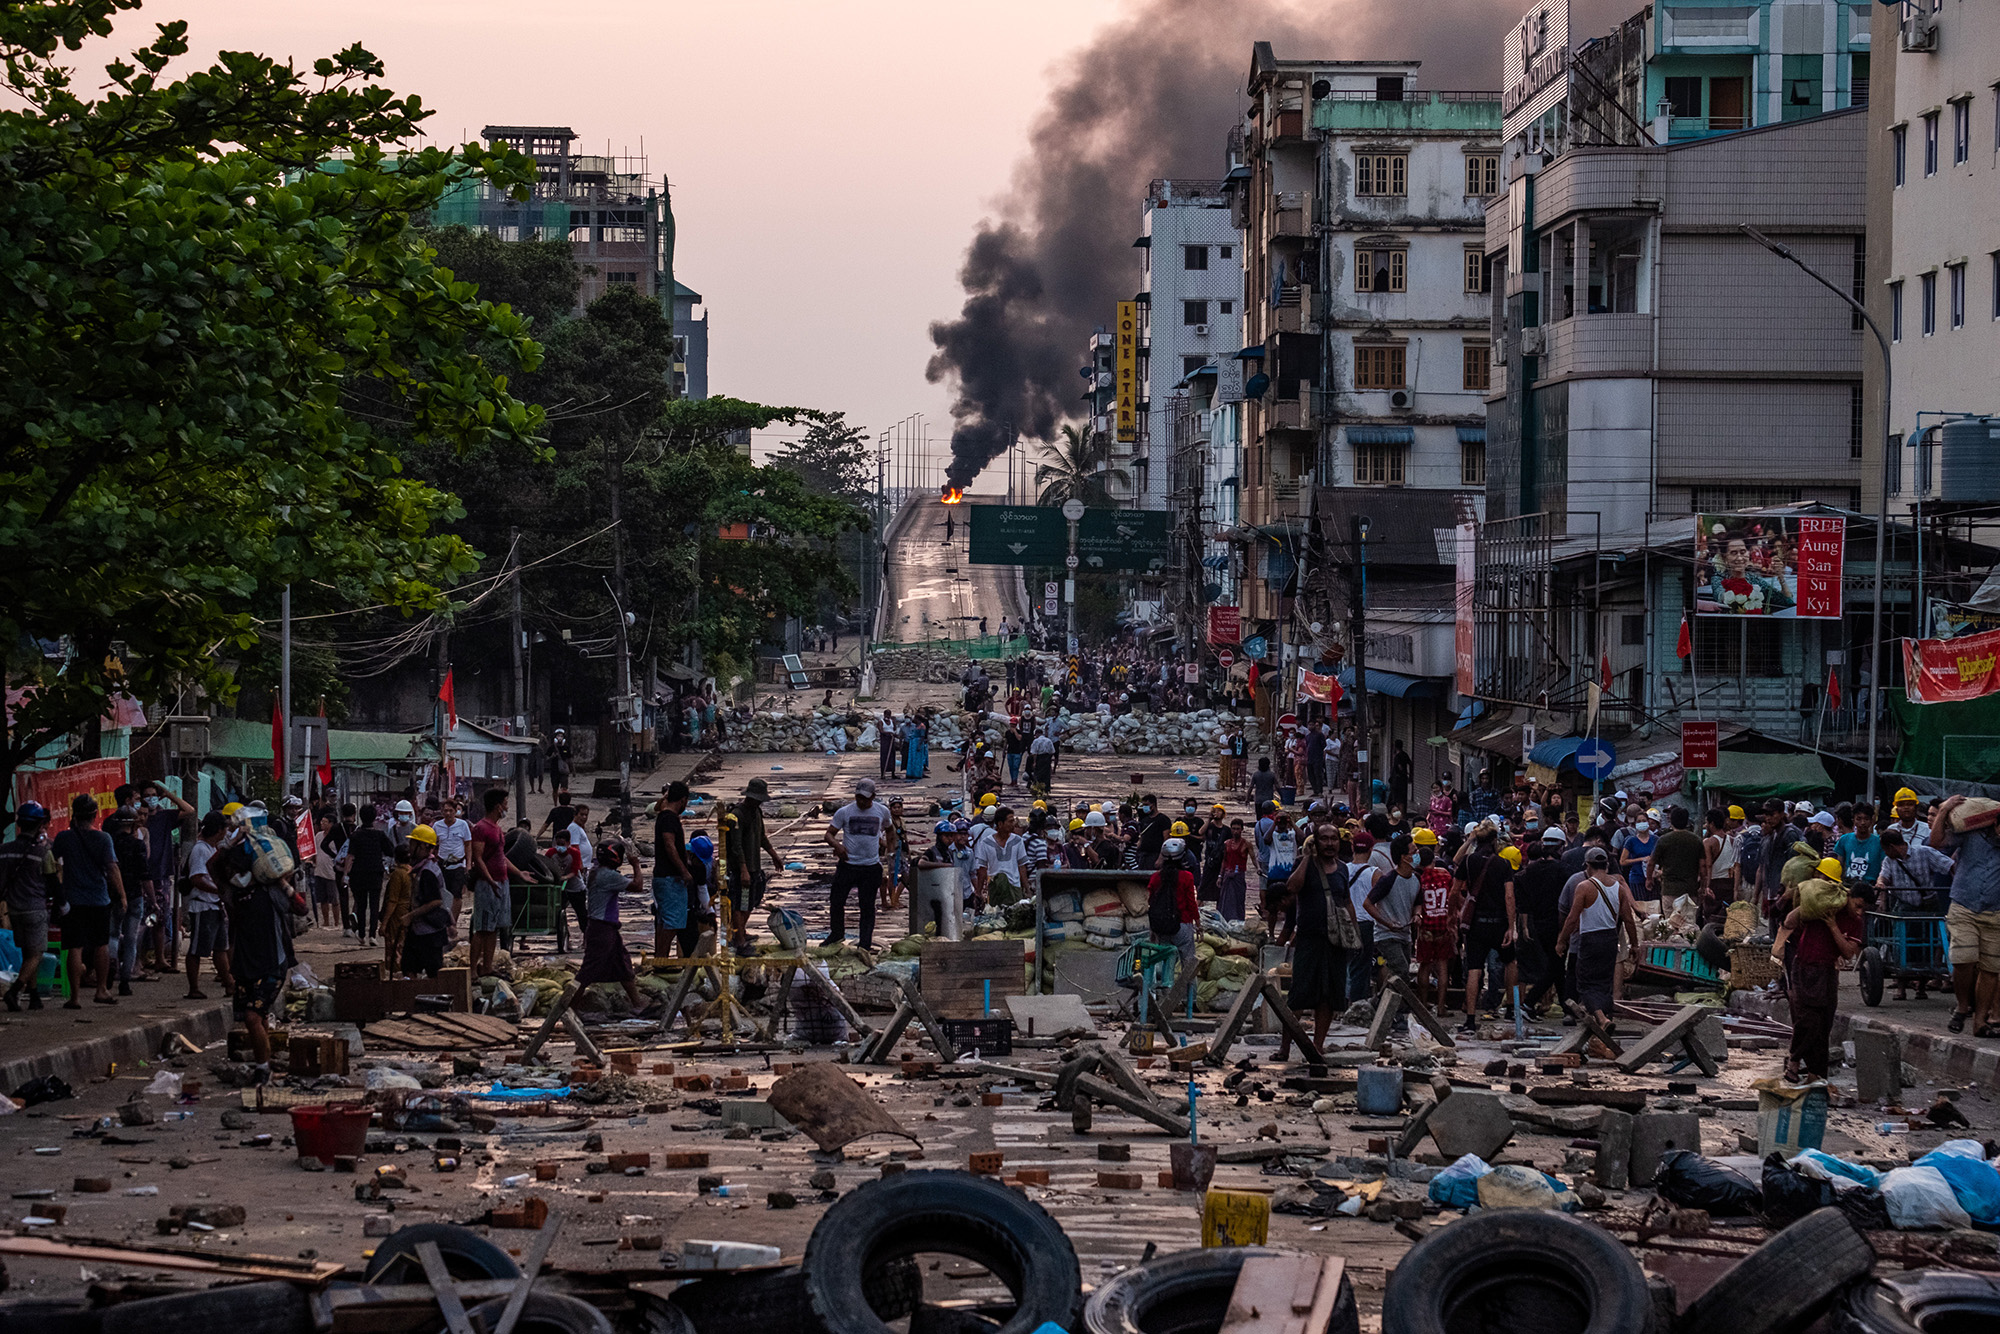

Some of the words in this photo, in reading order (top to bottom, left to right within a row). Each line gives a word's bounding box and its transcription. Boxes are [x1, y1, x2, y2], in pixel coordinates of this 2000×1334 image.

[1122, 306, 1132, 359] LONE
[1122, 368, 1132, 422] STAR
[1800, 519, 1842, 533] FREE
[1801, 538, 1839, 556] Aung
[1808, 558, 1832, 572] San
[1810, 578, 1827, 591] Su
[1807, 597, 1830, 614] Kyi
[1424, 888, 1447, 909] 97
